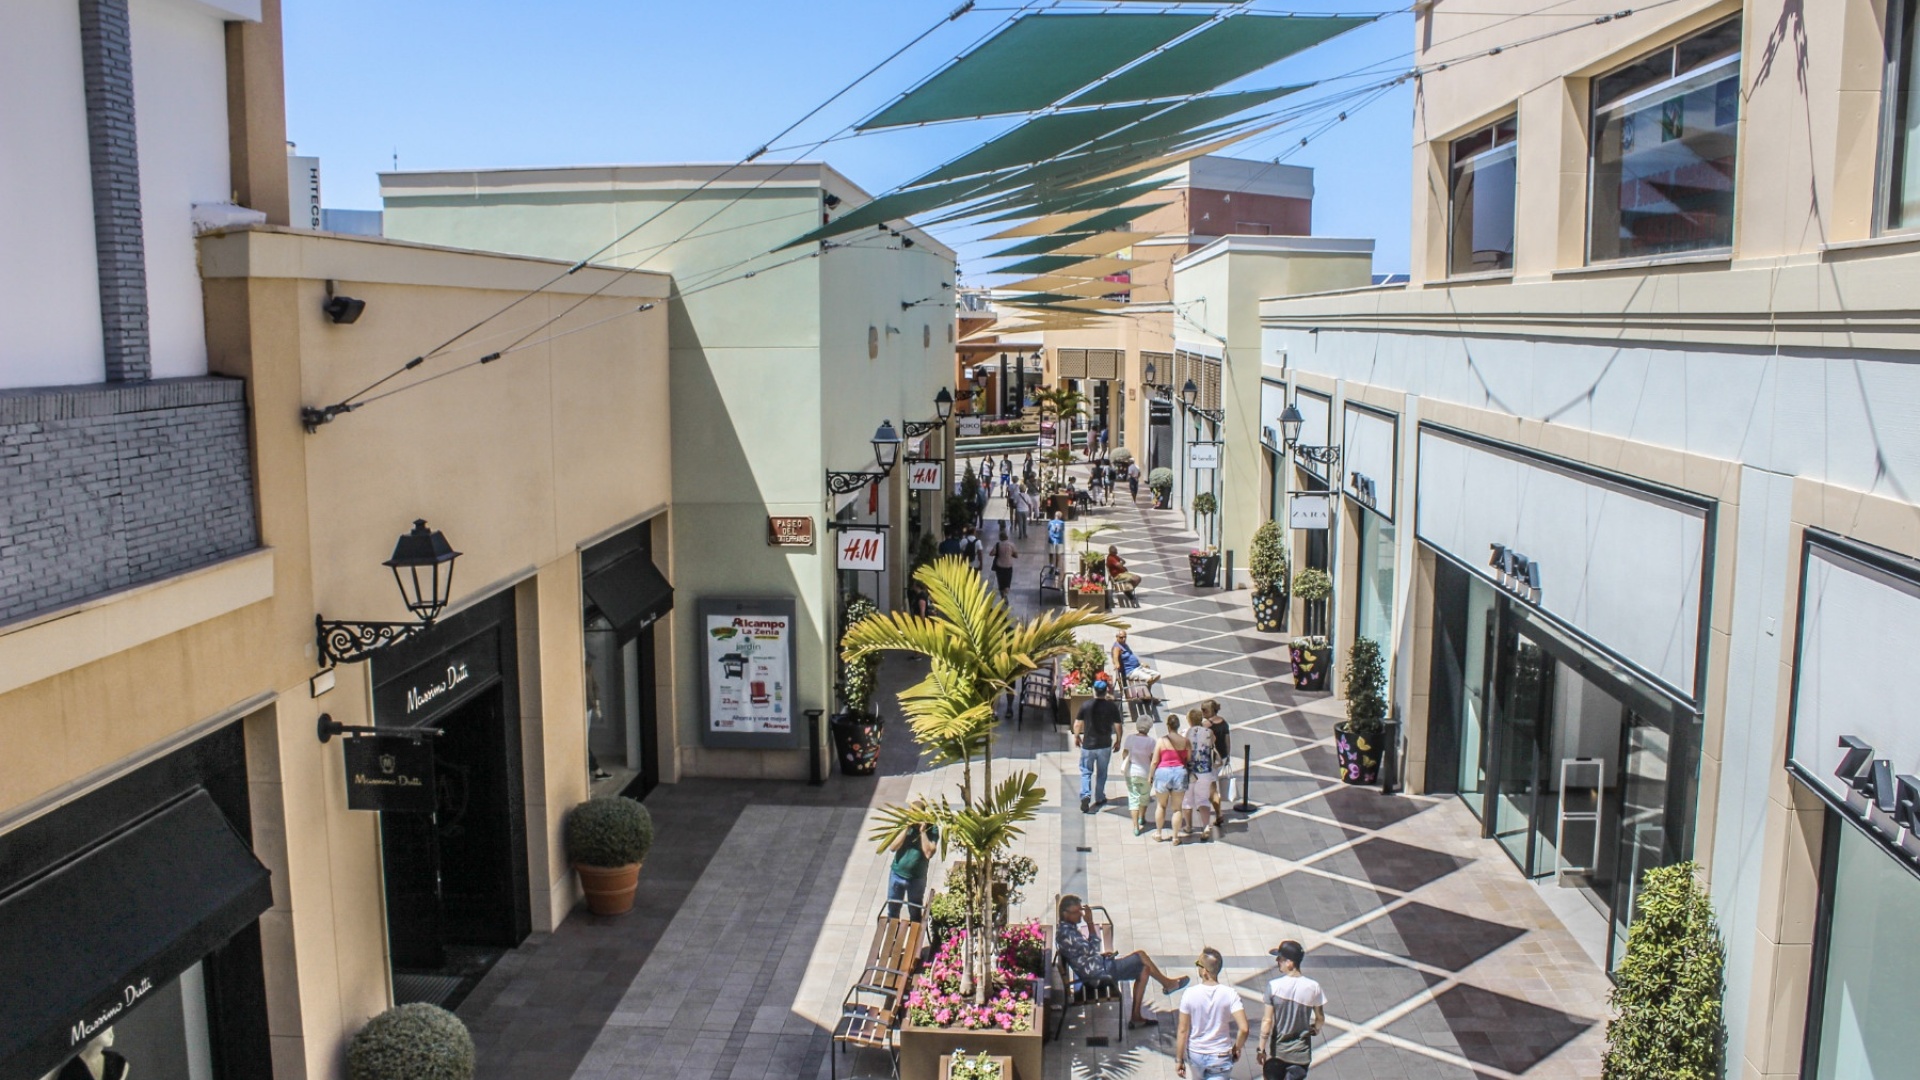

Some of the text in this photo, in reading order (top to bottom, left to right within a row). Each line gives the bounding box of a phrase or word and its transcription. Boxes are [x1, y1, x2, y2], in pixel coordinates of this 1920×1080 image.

[913, 468, 937, 484] H&M
[777, 519, 803, 528] PASEO
[782, 527, 797, 535] DEL
[844, 538, 879, 562] H&M
[732, 617, 785, 630] Alcampo
[754, 628, 779, 636] Zenia
[407, 664, 469, 714] Massimo Dutti
[71, 977, 153, 1046] Massimo Dutti
